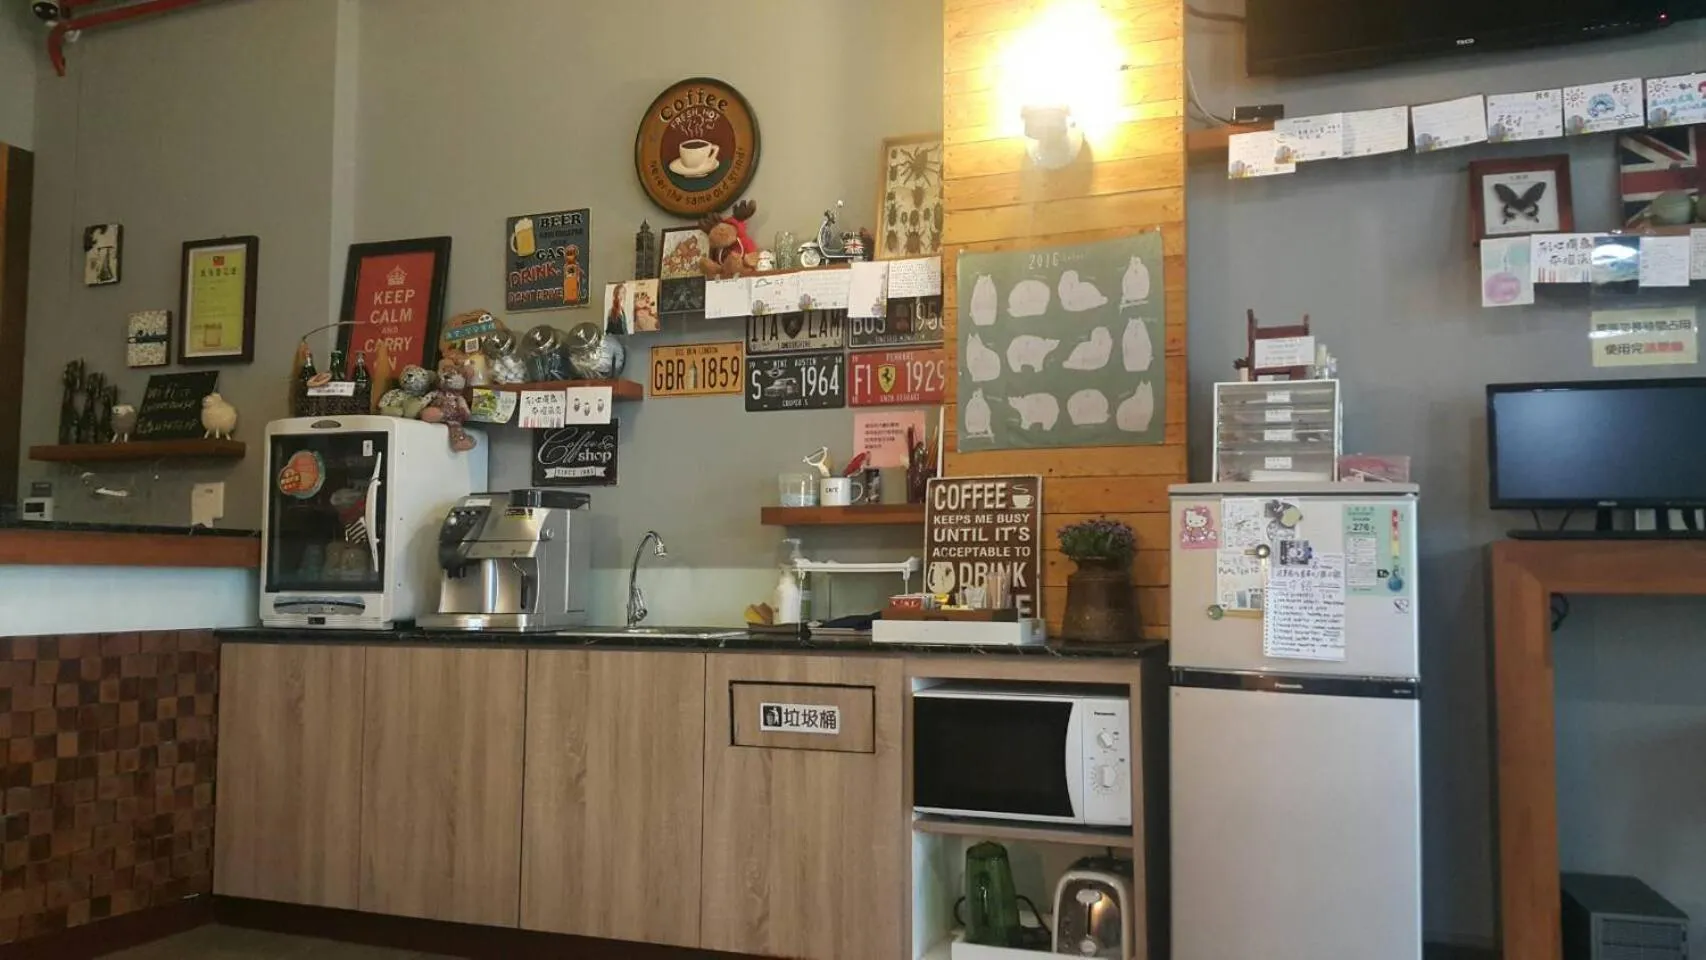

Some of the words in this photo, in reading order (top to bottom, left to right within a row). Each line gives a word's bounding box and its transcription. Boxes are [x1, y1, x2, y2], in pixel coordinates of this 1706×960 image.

[660, 88, 728, 122] Coffee
[671, 108, 699, 129] FRESH
[703, 108, 720, 121] HOT
[540, 213, 582, 229] BEER
[536, 246, 566, 261] GAS
[1029, 252, 1059, 270] 2016
[373, 288, 416, 306] KEEP
[369, 307, 413, 325] CALM
[381, 325, 398, 335] AND
[751, 314, 779, 342] ITA
[807, 310, 841, 339] LAM
[364, 336, 413, 353] CARRY
[372, 355, 397, 371] N
[654, 358, 686, 391] GBR
[701, 355, 740, 389] 1859
[751, 369, 762, 400] S
[800, 364, 840, 397] 1964
[854, 363, 871, 396] F1
[906, 359, 945, 393] 1929
[578, 447, 612, 463] shop
[934, 482, 1007, 511] COFFEE
[933, 514, 971, 525] KEEPS
[975, 515, 993, 524] ME
[996, 513, 1030, 524] BUSY
[933, 527, 989, 543] UNTIL
[995, 526, 1031, 542] IT'S
[932, 546, 1012, 558] ACCEPTABLE
[1015, 546, 1031, 556] TO
[783, 708, 838, 730] 垃圾桶
